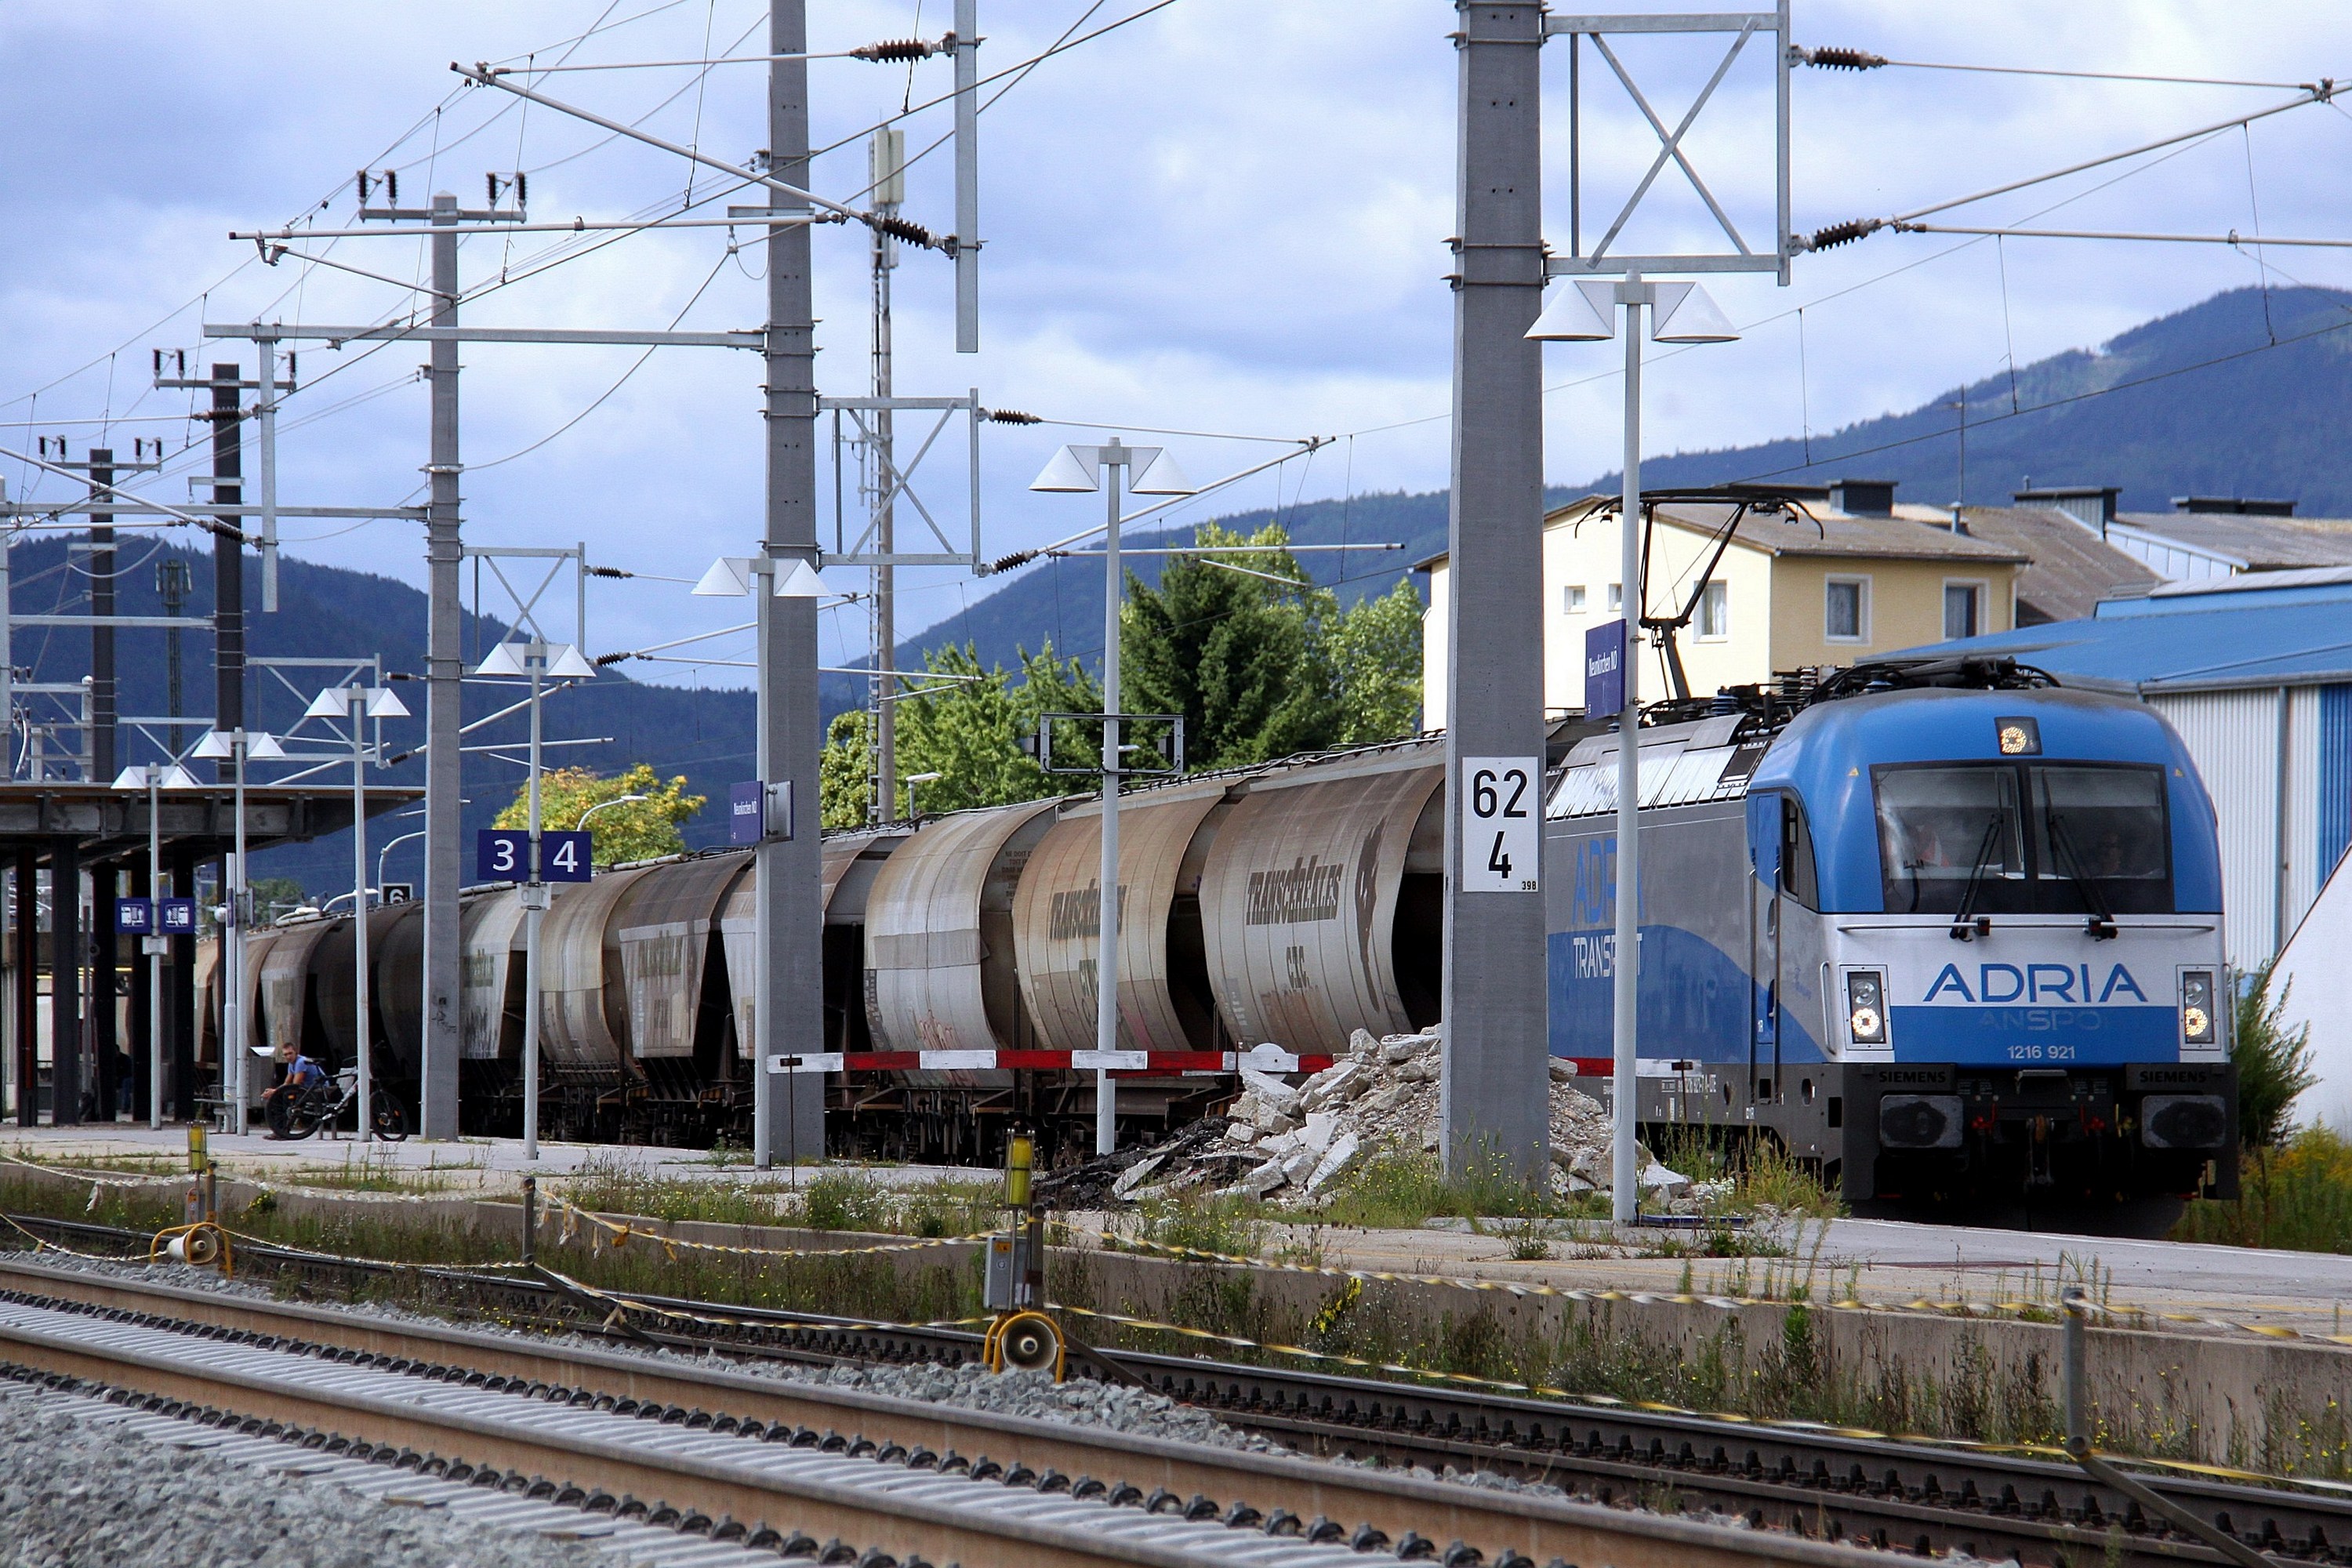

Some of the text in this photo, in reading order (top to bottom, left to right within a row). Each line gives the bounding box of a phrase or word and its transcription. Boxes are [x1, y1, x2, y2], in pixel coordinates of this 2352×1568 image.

[1473, 769, 1528, 818] 62
[492, 839, 514, 872] 3
[553, 840, 579, 873] 4
[1488, 831, 1512, 879] 4
[1522, 880, 1537, 891] 398
[1571, 837, 1645, 925] ADR
[1922, 963, 2148, 1003] ADRIA
[2007, 1045, 2075, 1059] 1216 921
[1878, 1071, 1946, 1083] SIEMENS
[2140, 1070, 2207, 1083] SIEMENS
